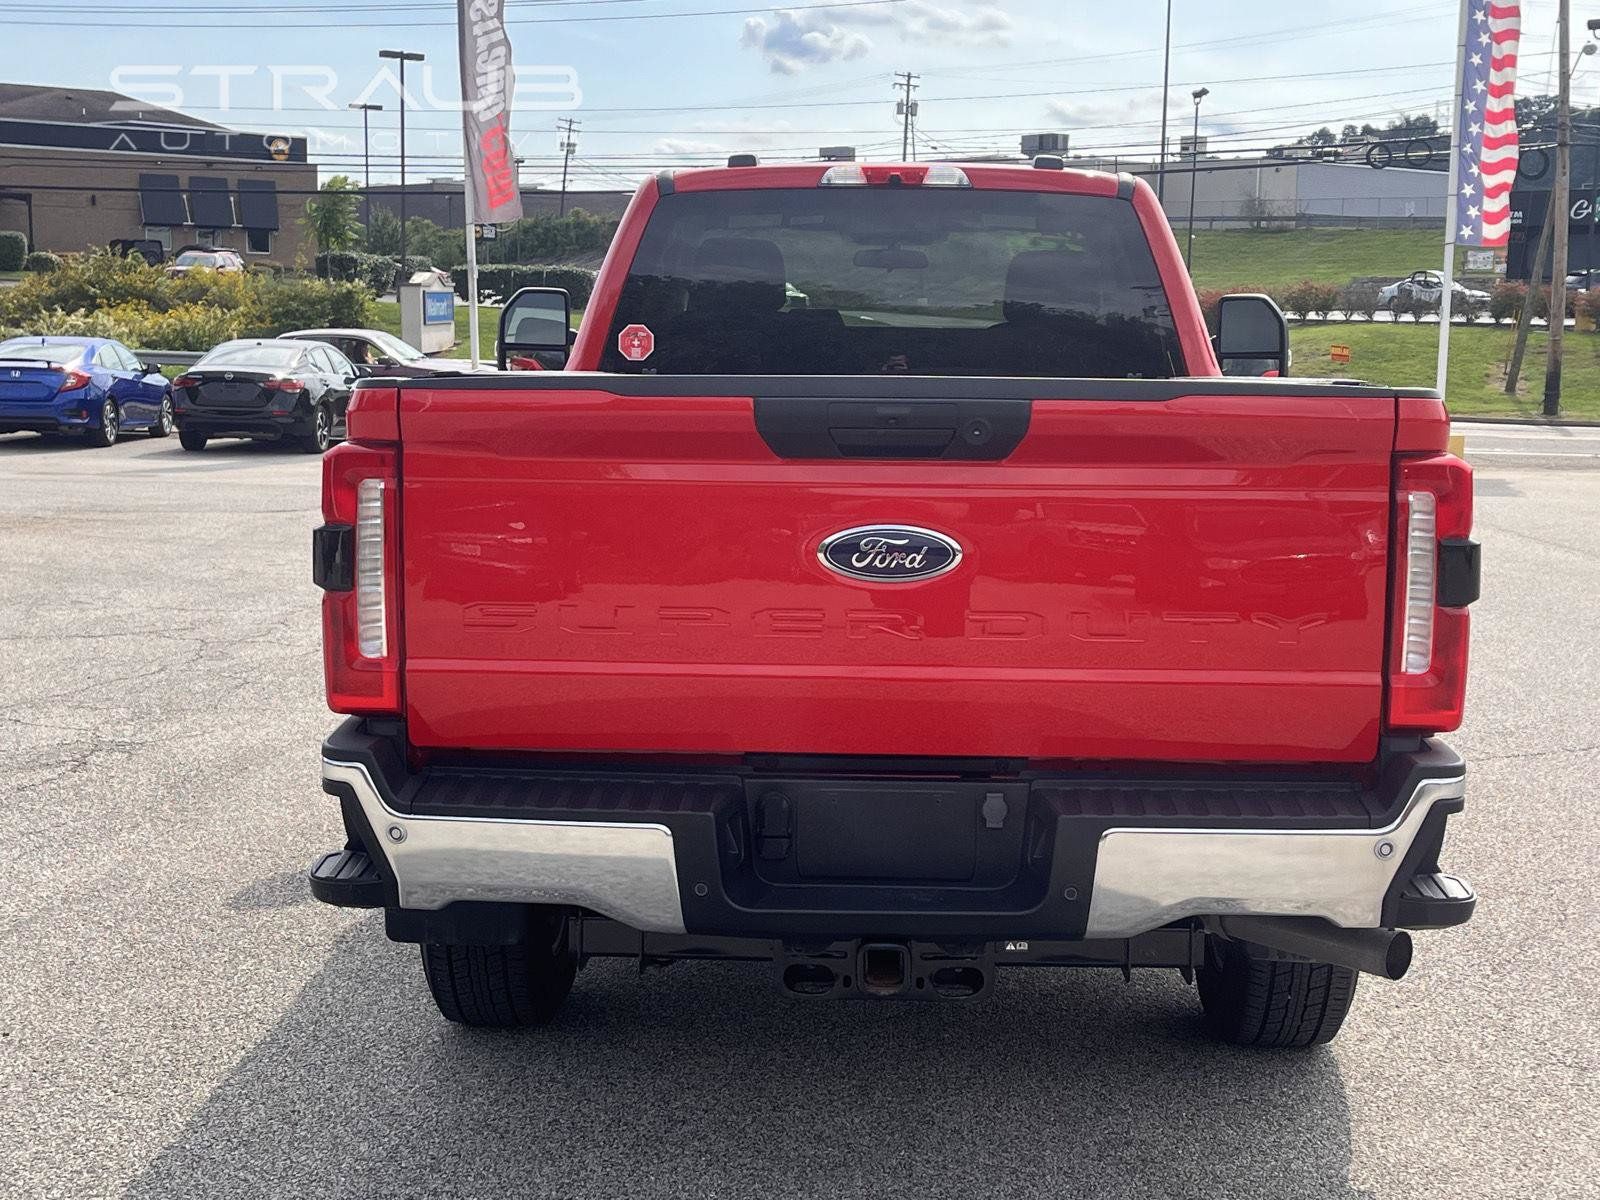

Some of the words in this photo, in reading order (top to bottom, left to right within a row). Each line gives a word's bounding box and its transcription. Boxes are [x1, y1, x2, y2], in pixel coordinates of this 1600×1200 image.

[851, 536, 927, 569] Ford
[463, 602, 924, 639] SUPER
[965, 611, 1330, 645] DUTY
